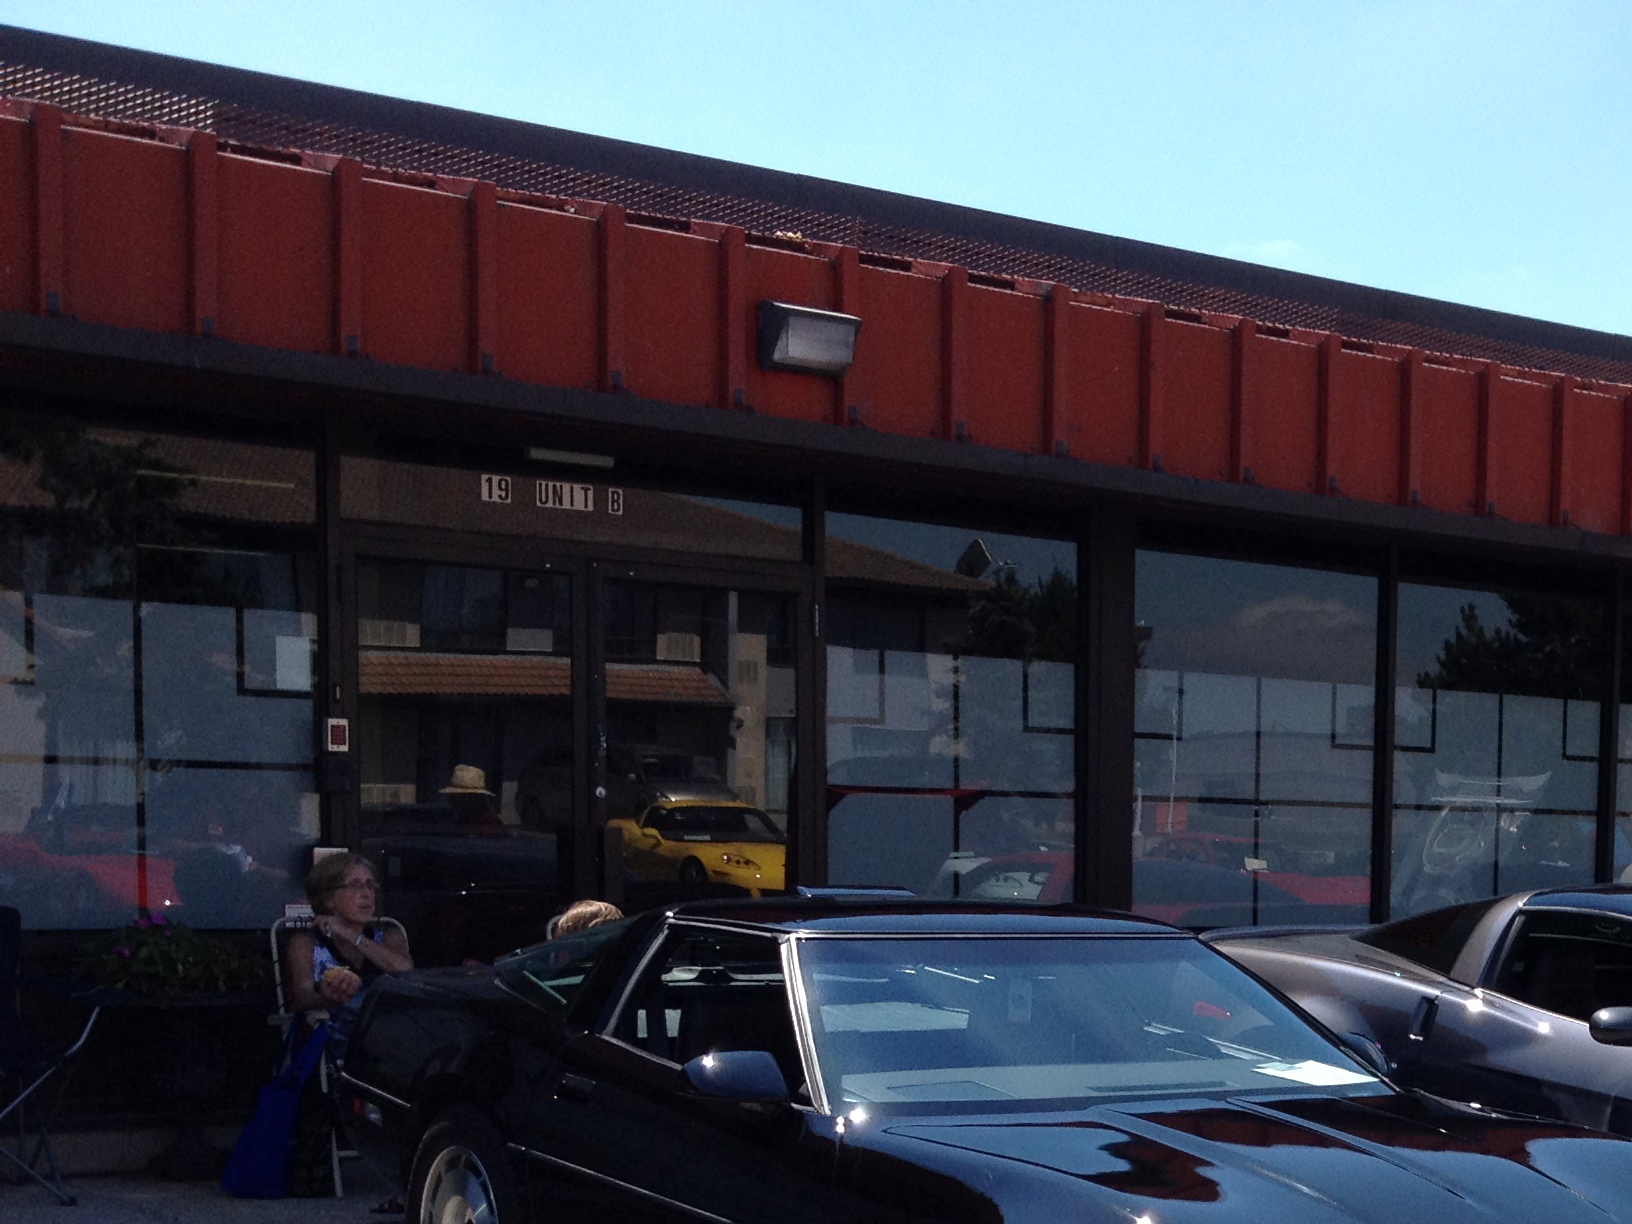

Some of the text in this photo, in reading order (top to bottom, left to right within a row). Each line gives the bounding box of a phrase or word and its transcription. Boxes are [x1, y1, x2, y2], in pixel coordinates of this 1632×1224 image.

[484, 476, 622, 513] 19 UNIT B
